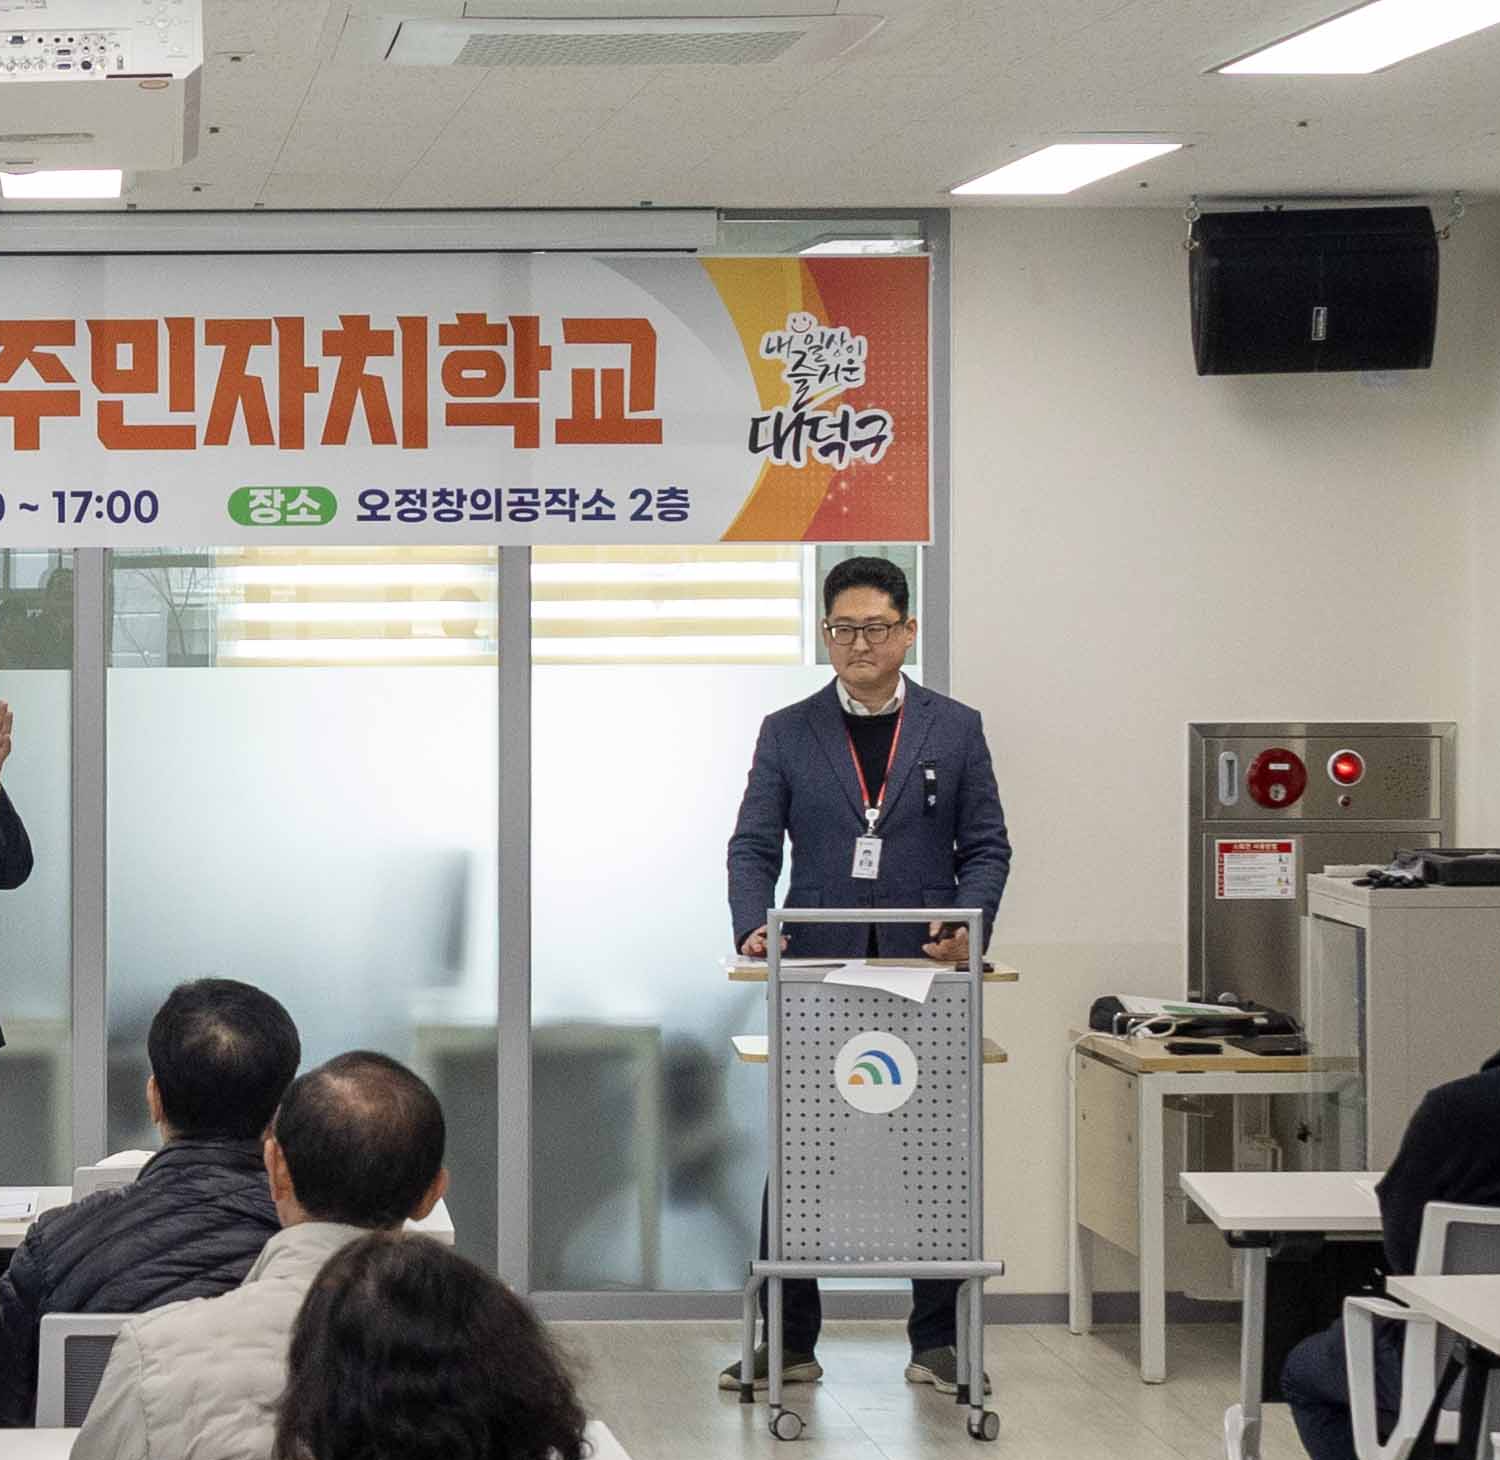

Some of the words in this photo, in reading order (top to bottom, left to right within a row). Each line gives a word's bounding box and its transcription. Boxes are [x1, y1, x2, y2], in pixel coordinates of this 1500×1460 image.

[765, 336, 793, 358] 내
[804, 331, 862, 362] 일상이
[787, 350, 861, 413] 즐거운
[749, 410, 887, 464] 대덕구
[55, 490, 159, 524] 17:00
[247, 487, 324, 524] 장소
[358, 487, 616, 523] 오정창의공작소
[631, 486, 689, 523] 2층
